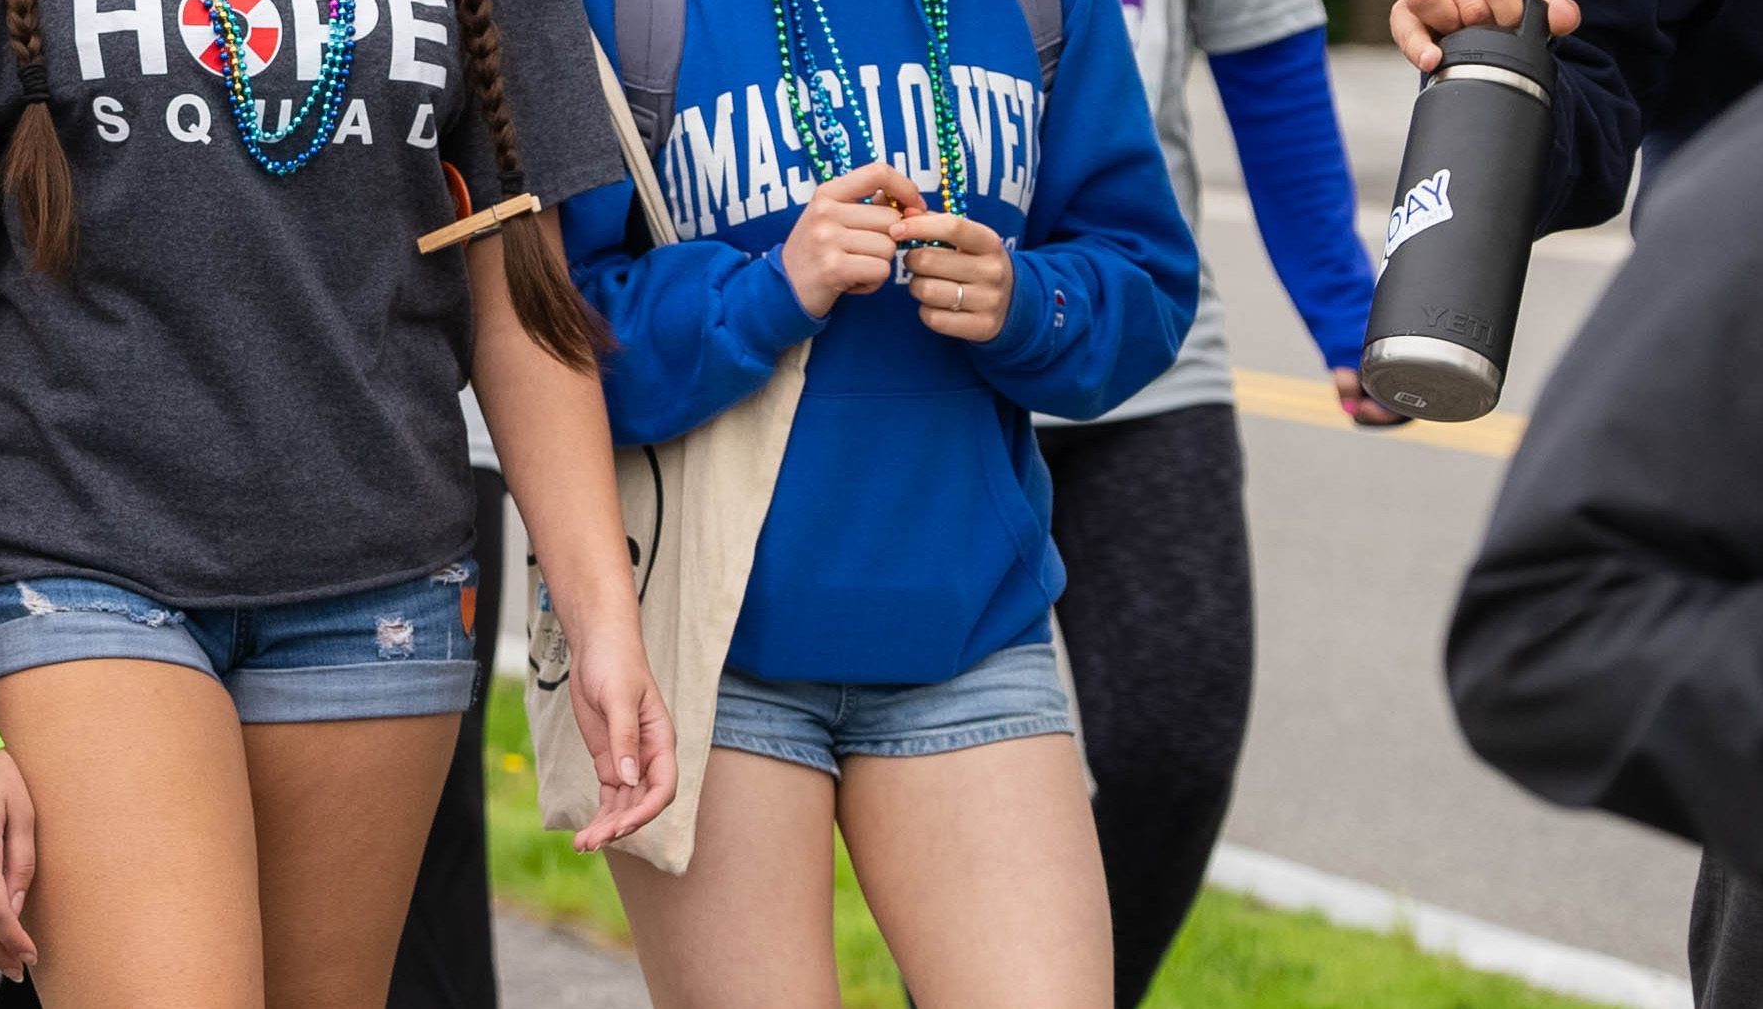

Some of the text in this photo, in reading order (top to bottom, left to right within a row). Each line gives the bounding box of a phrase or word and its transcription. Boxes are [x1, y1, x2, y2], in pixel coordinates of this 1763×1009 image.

[92, 94, 437, 150] SQUAD
[663, 62, 1045, 241] UMASS LOWEL
[1421, 304, 1495, 349] YETI
